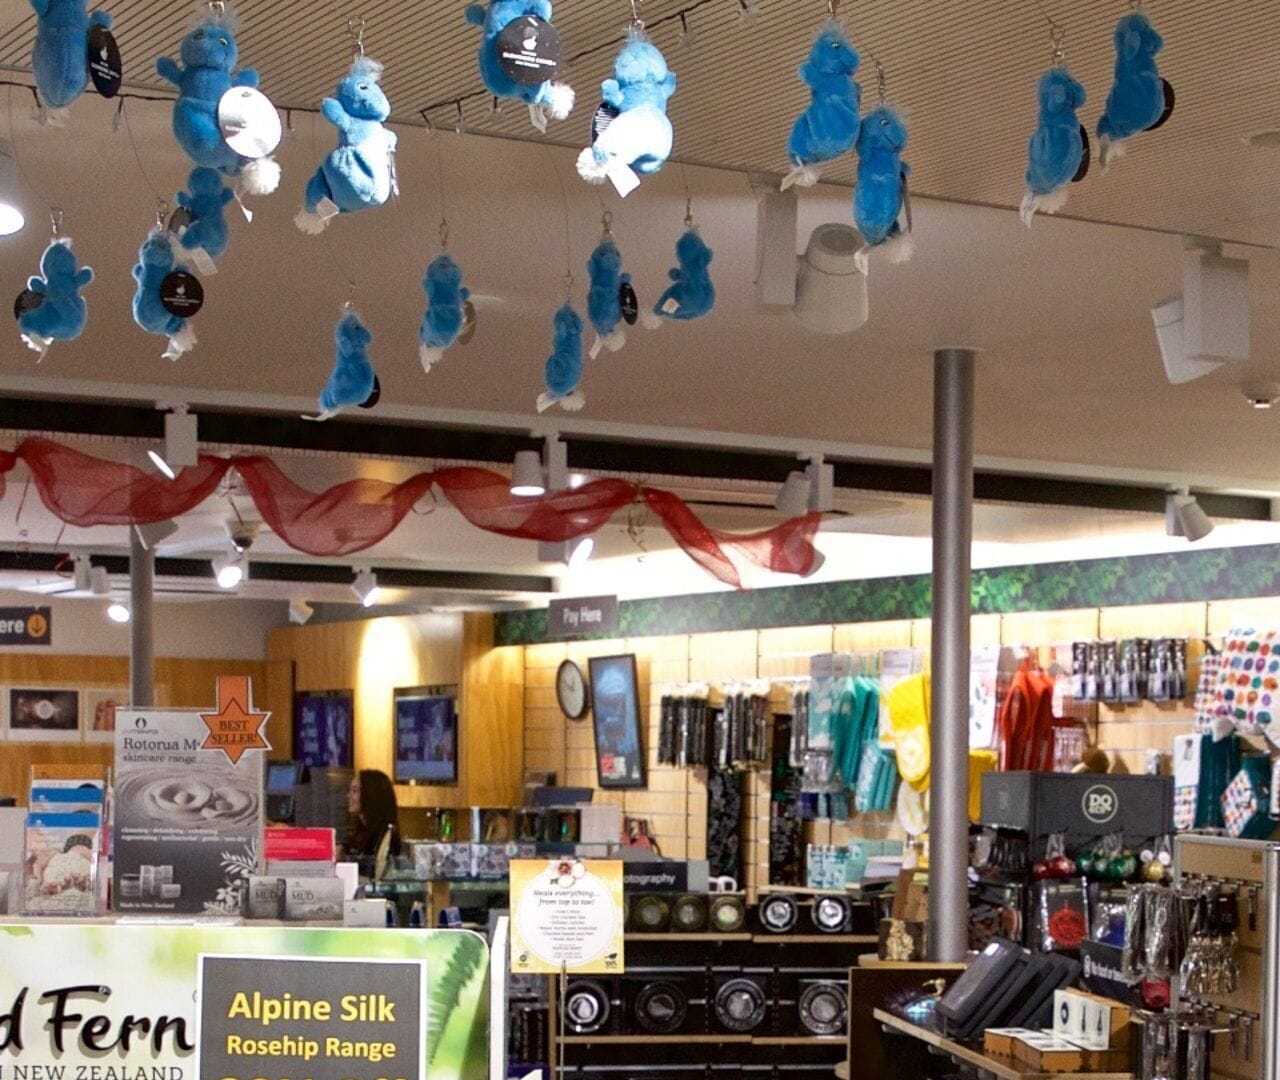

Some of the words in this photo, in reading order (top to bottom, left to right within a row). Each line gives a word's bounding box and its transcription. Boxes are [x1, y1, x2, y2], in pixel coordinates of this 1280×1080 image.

[580, 605, 602, 623] Here
[219, 720, 250, 732] BEST
[123, 737, 180, 751] Rotorua
[123, 753, 166, 763] skincare
[168, 755, 198, 765] range
[292, 890, 314, 901] MUD
[227, 991, 332, 1026] Alpine
[339, 994, 396, 1022] Silk
[40, 984, 196, 1053] Fern
[226, 1035, 319, 1061] Rosehip
[325, 1036, 397, 1063] Range
